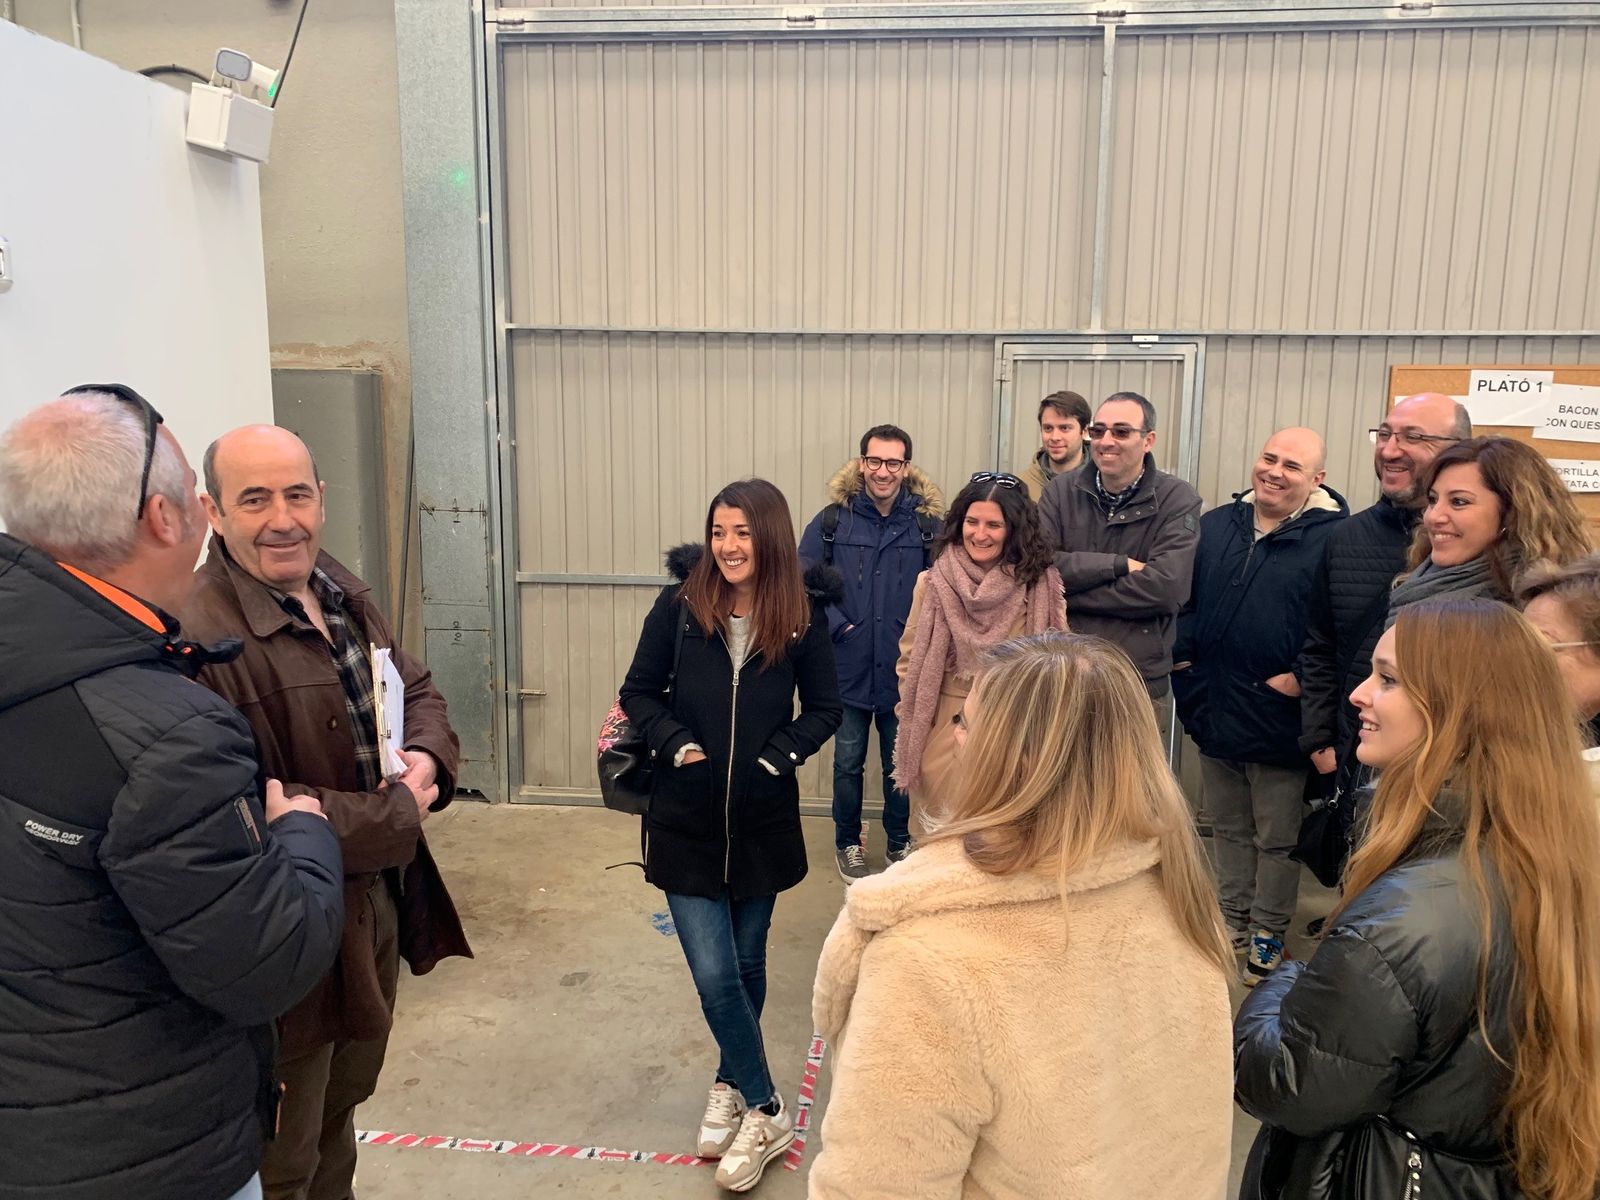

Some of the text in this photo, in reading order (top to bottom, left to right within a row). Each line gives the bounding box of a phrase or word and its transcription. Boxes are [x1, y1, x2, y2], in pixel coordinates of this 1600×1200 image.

[1477, 378, 1543, 393] PLATÓ 1
[1558, 404, 1599, 416] BACON
[1570, 419, 1600, 430] QUES
[25, 819, 60, 837] POWER
[61, 831, 84, 841] DRY
